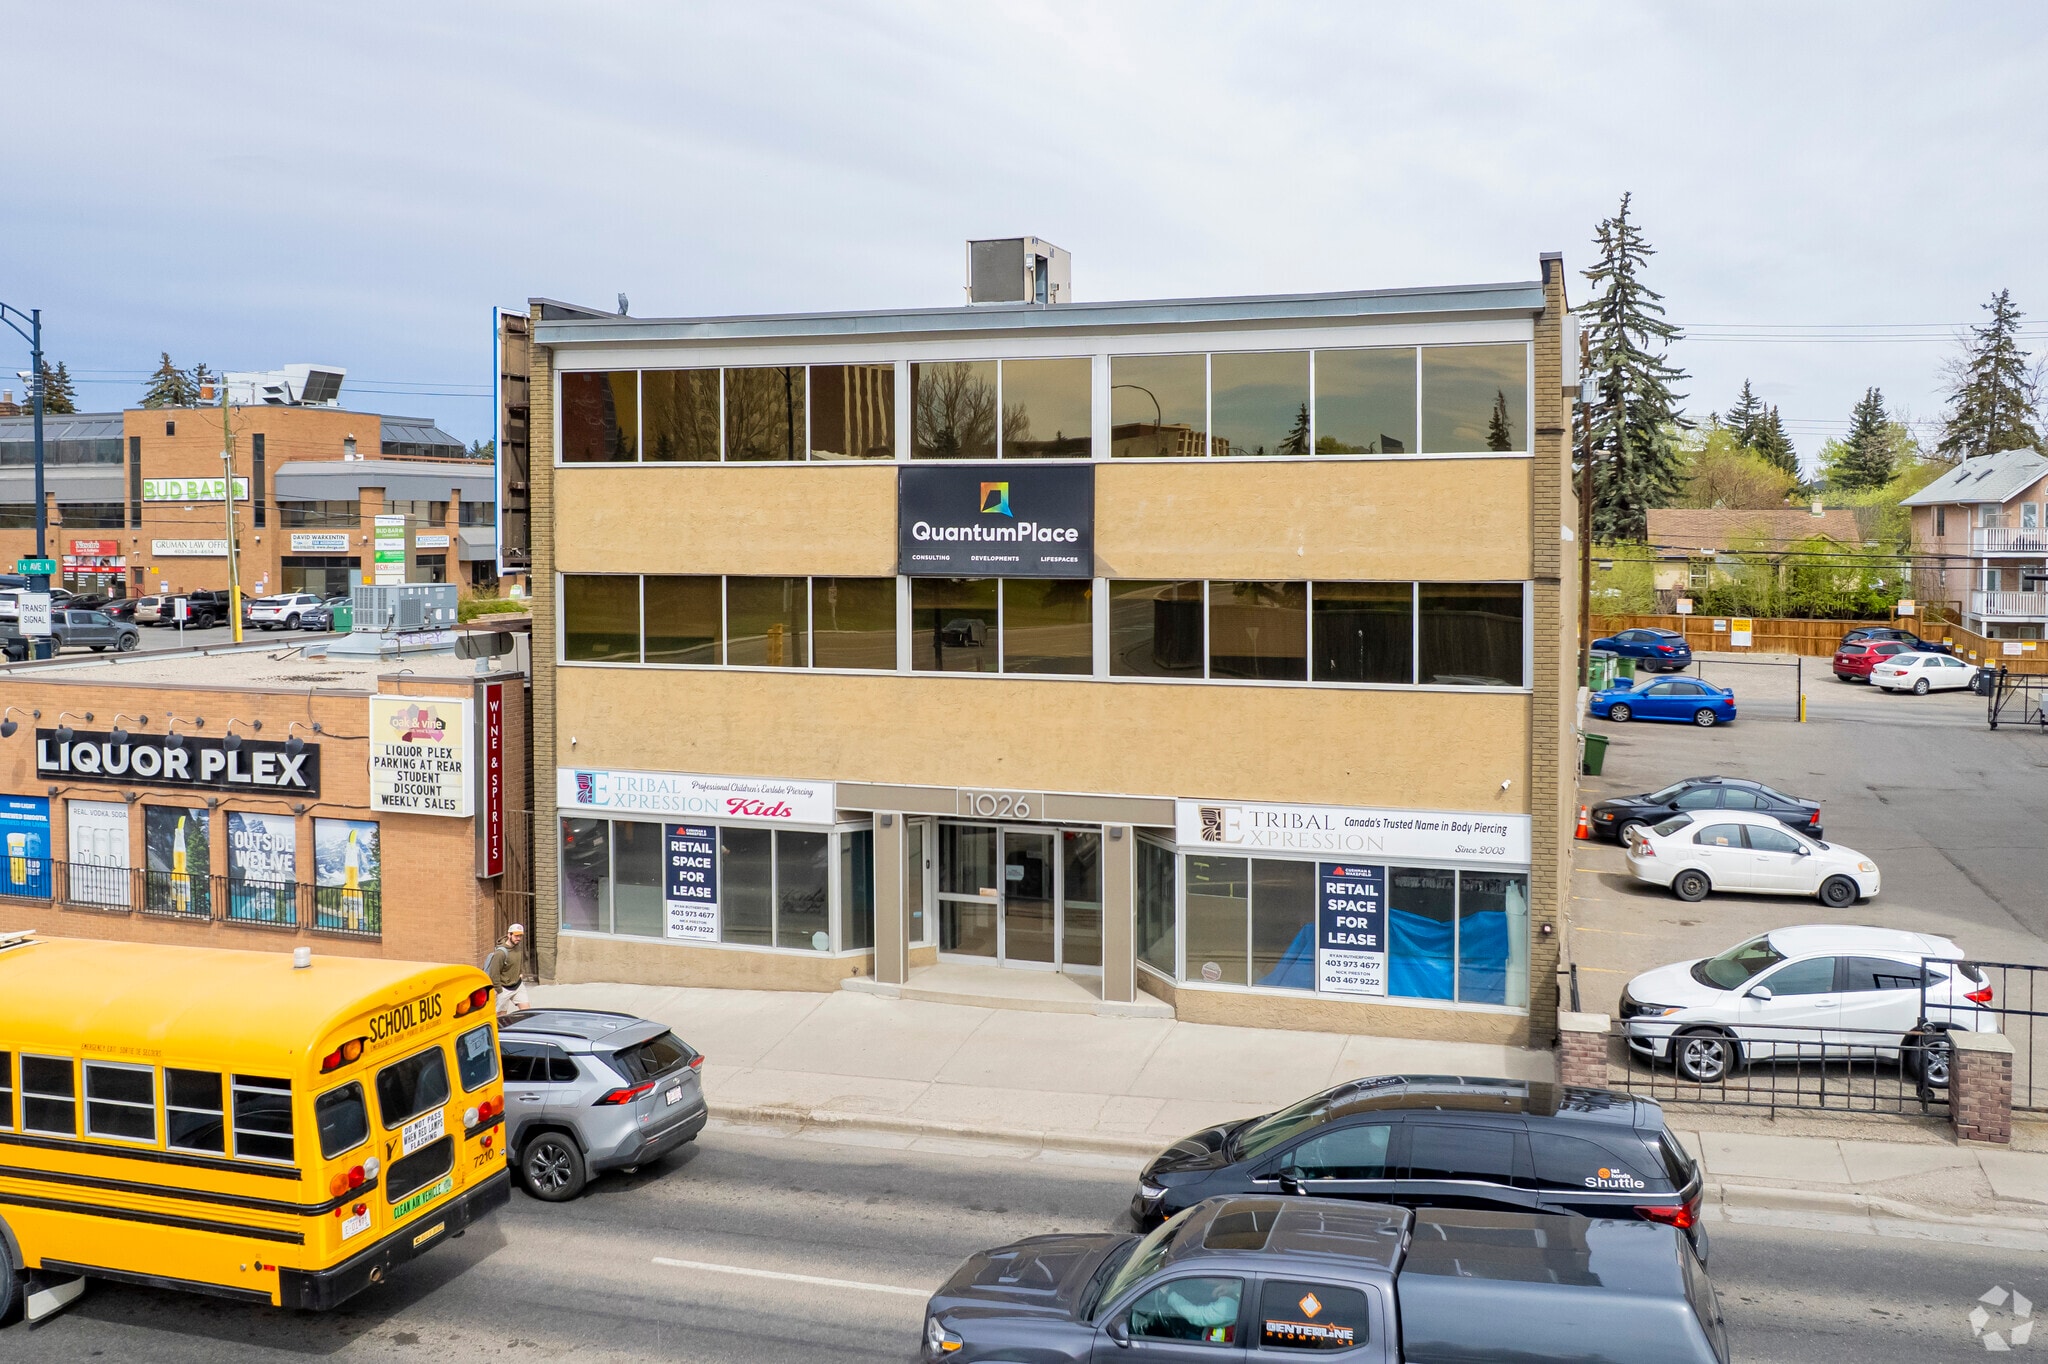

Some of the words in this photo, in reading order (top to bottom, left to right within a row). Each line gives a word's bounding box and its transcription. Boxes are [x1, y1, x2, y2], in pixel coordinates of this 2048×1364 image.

[144, 481, 182, 499] BUD
[187, 481, 226, 499] BAR
[912, 521, 1079, 543] QuantumPlace
[155, 540, 188, 549] GRUMAN
[189, 541, 205, 549] LAW
[208, 541, 229, 549] OFFIC
[19, 563, 27, 571] 16
[30, 562, 42, 571] AVE
[45, 562, 50, 570] N
[22, 604, 47, 612] TRANSIT
[24, 615, 46, 624] SIGNAL
[392, 717, 409, 728] oak
[412, 717, 420, 728] &
[422, 719, 442, 729] vine
[489, 700, 500, 749] WINE
[386, 745, 422, 757] LIQUOR
[427, 747, 452, 759] PLEX
[37, 738, 193, 780] LIQUOR
[201, 748, 309, 787] PLEX
[374, 757, 416, 770] PARKING
[420, 759, 433, 770] AT
[437, 761, 462, 772] REAR
[491, 757, 498, 768] &
[397, 770, 440, 783] STUDENT
[394, 783, 442, 796] DISCOUNT
[613, 776, 681, 795] TRIBAL
[691, 780, 730, 793] Professional
[730, 782, 760, 794] Children's
[760, 784, 786, 795] Earlobe
[786, 785, 814, 798] Piercing
[381, 795, 419, 807] WEEKLY
[425, 798, 456, 810] SALES
[726, 797, 793, 818] Kids
[966, 792, 1030, 818] 1026
[491, 774, 499, 859] SPIRITS
[1249, 811, 1335, 831] TRIBAL
[1344, 816, 1381, 828] Canada's
[1383, 818, 1413, 830] Trusted
[1414, 820, 1439, 831] Name
[1441, 820, 1449, 831] in
[1451, 821, 1472, 835] Body
[1474, 822, 1508, 837] Piercing
[234, 830, 294, 853] OUTSIDE
[671, 841, 713, 854] RETAIL
[1454, 845, 1477, 854] Since
[236, 850, 259, 868] WE
[260, 852, 293, 871] LIVE
[672, 856, 711, 868] SPACE
[243, 870, 286, 891] AGAIN
[679, 871, 704, 882] FOR
[673, 885, 711, 898] LEASE
[1326, 882, 1379, 896] RETAIL
[1327, 899, 1377, 913] SPACE
[685, 910, 697, 918] 973
[698, 911, 715, 919] 4677
[1336, 916, 1368, 928] FOR
[1328, 932, 1377, 946] LEASE
[1343, 960, 1358, 968] 973
[1360, 961, 1380, 970] 4677
[1360, 978, 1380, 986] 9222
[369, 1004, 417, 1043] SCHOOL
[419, 993, 442, 1023] BUS
[404, 1125, 413, 1134] DO
[414, 1120, 425, 1130] NOT
[427, 1110, 442, 1124] PASS
[404, 1132, 416, 1145] WHEN
[418, 1127, 427, 1138] RED
[428, 1118, 443, 1133] LAMPS
[410, 1131, 438, 1150] FLASHING
[474, 1148, 495, 1168] 7210
[1584, 1177, 1645, 1188] Shuttle
[394, 1202, 411, 1219] CLEAN
[411, 1195, 420, 1211] AIR
[421, 1183, 441, 1205] VEHICLE
